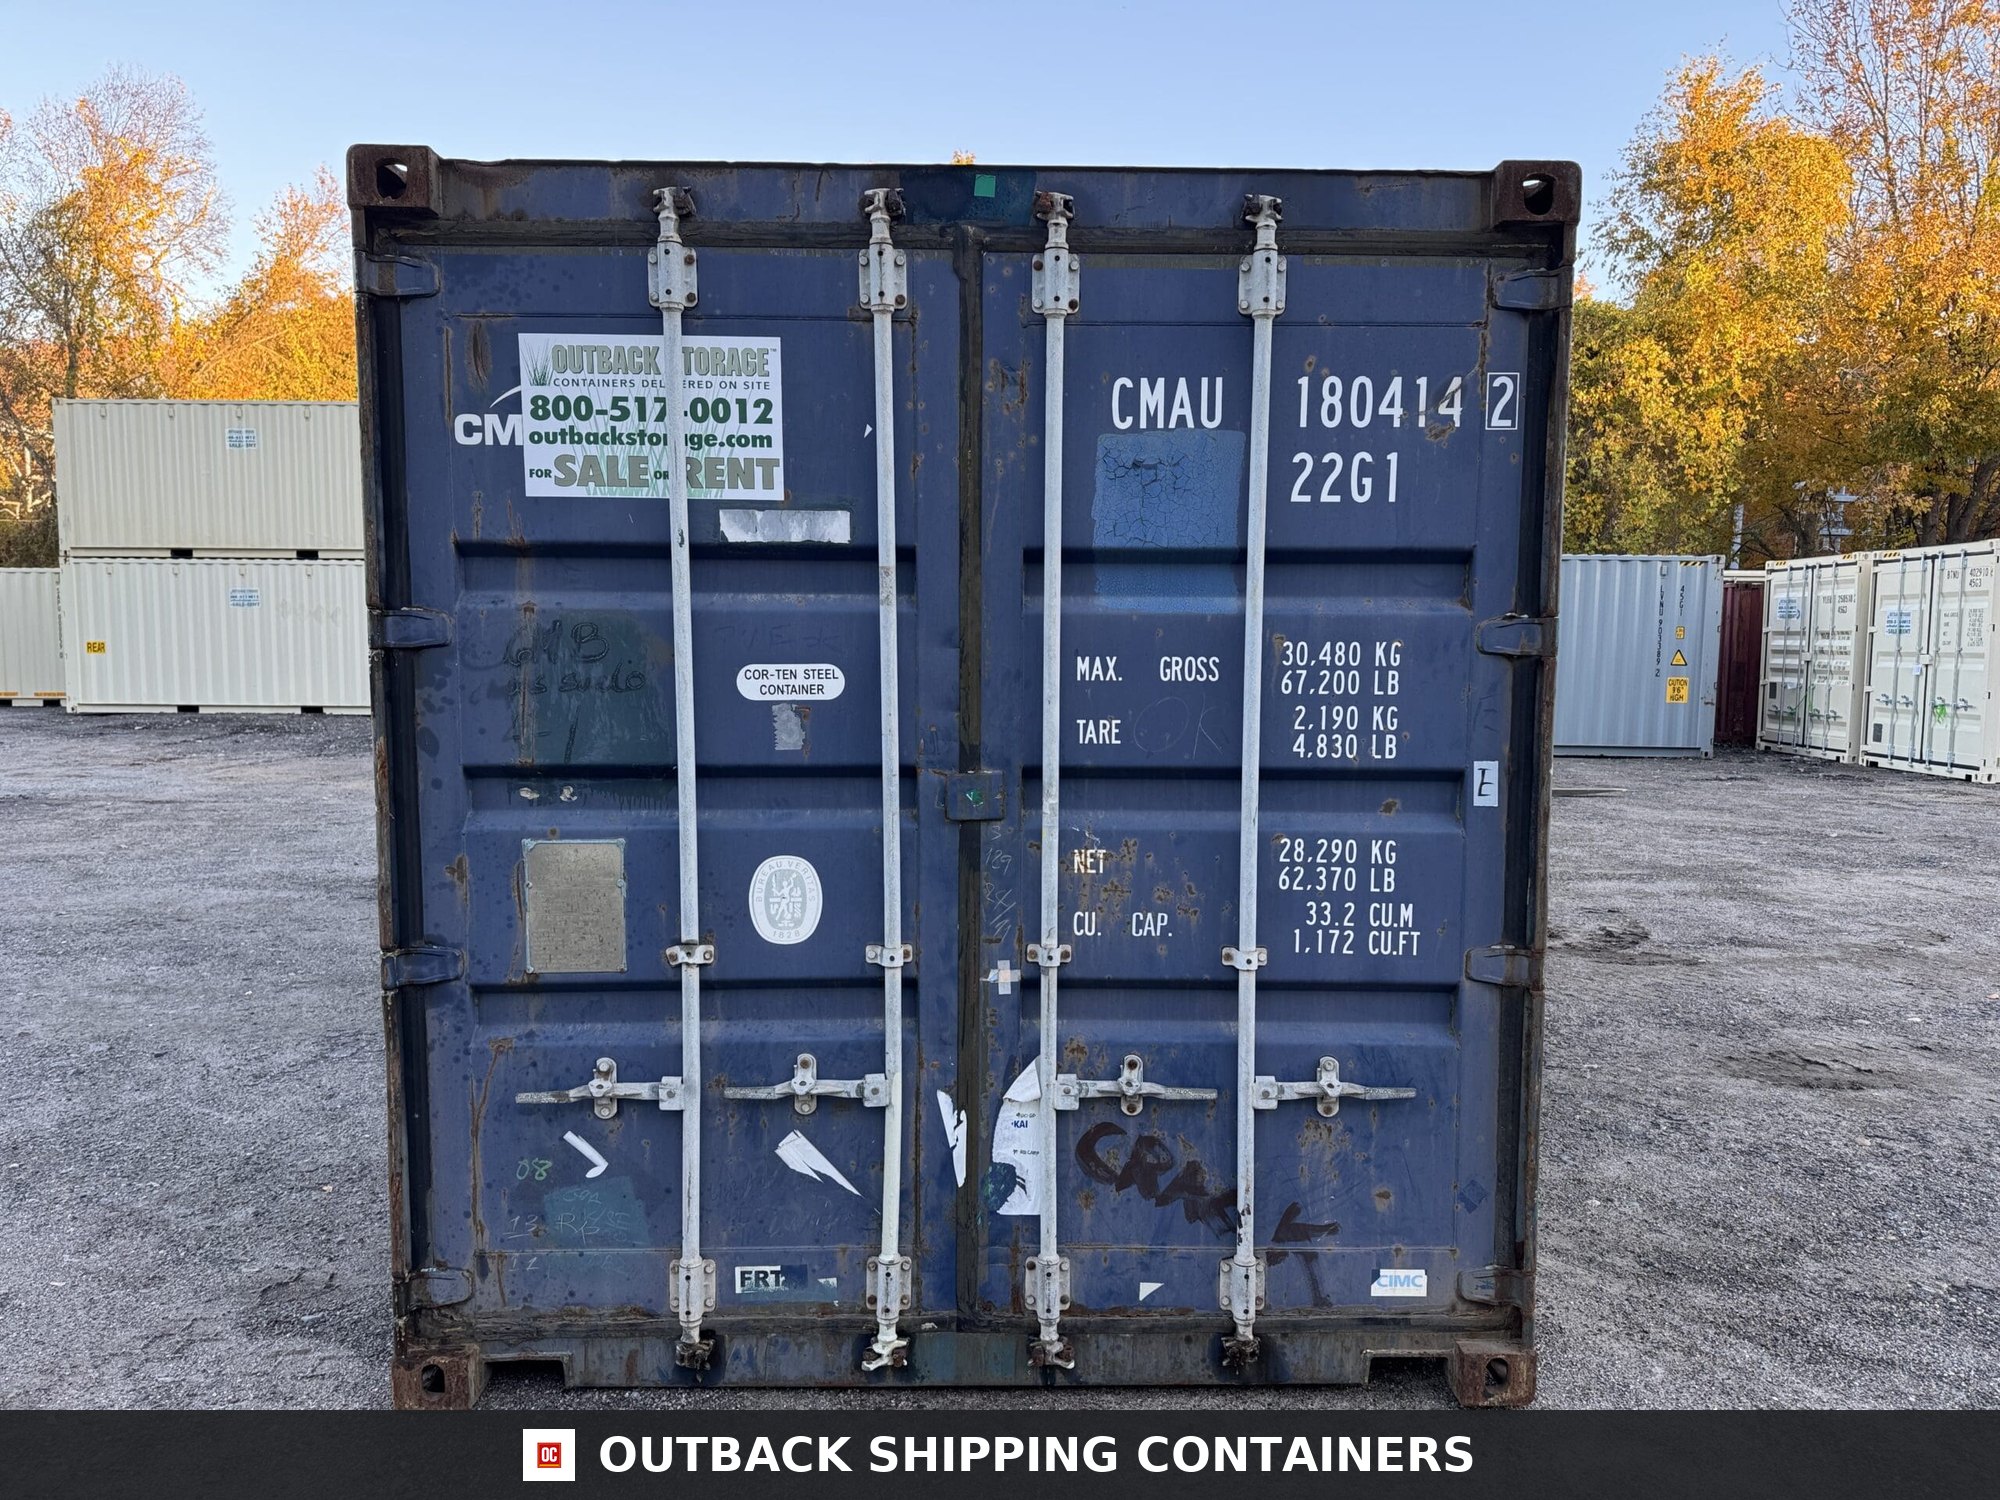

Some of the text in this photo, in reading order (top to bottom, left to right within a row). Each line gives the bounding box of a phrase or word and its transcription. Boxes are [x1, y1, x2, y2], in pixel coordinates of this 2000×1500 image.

[551, 344, 662, 375] OUTBACK
[682, 346, 770, 377] TORAGE
[553, 377, 636, 388] CONTAINERS
[719, 381, 737, 390] ON
[743, 381, 771, 391] SITE
[1111, 374, 1516, 430] CMAU 180414 2
[529, 468, 552, 479] FOR
[553, 453, 650, 488] SALE
[685, 456, 781, 490] RENT
[1289, 451, 1399, 504] 22G1
[86, 641, 106, 654] REAR
[1281, 641, 1402, 667] 30,480 KG
[744, 668, 840, 681] COR-TEN STEEL
[1076, 655, 1221, 682] MAX. GROSS
[759, 683, 826, 696] CONTAINER
[1281, 669, 1400, 695] 67,200 LB
[1293, 705, 1399, 731] 2,190 KG
[1076, 719, 1122, 745] TARE
[1292, 733, 1397, 759] 4,830 LB
[1073, 849, 1107, 874] NET
[1278, 837, 1397, 865] 28,290 KG
[755, 860, 816, 903] BUREAU VERITAS
[1278, 865, 1396, 893] 62,370 LB
[1073, 911, 1173, 937] CU. CAP.
[1305, 901, 1414, 928] 33.2 CU.M
[772, 929, 801, 939] 1828
[1294, 928, 1421, 956] 1,172 CU.FT
[1376, 1274, 1424, 1288] CIMC
